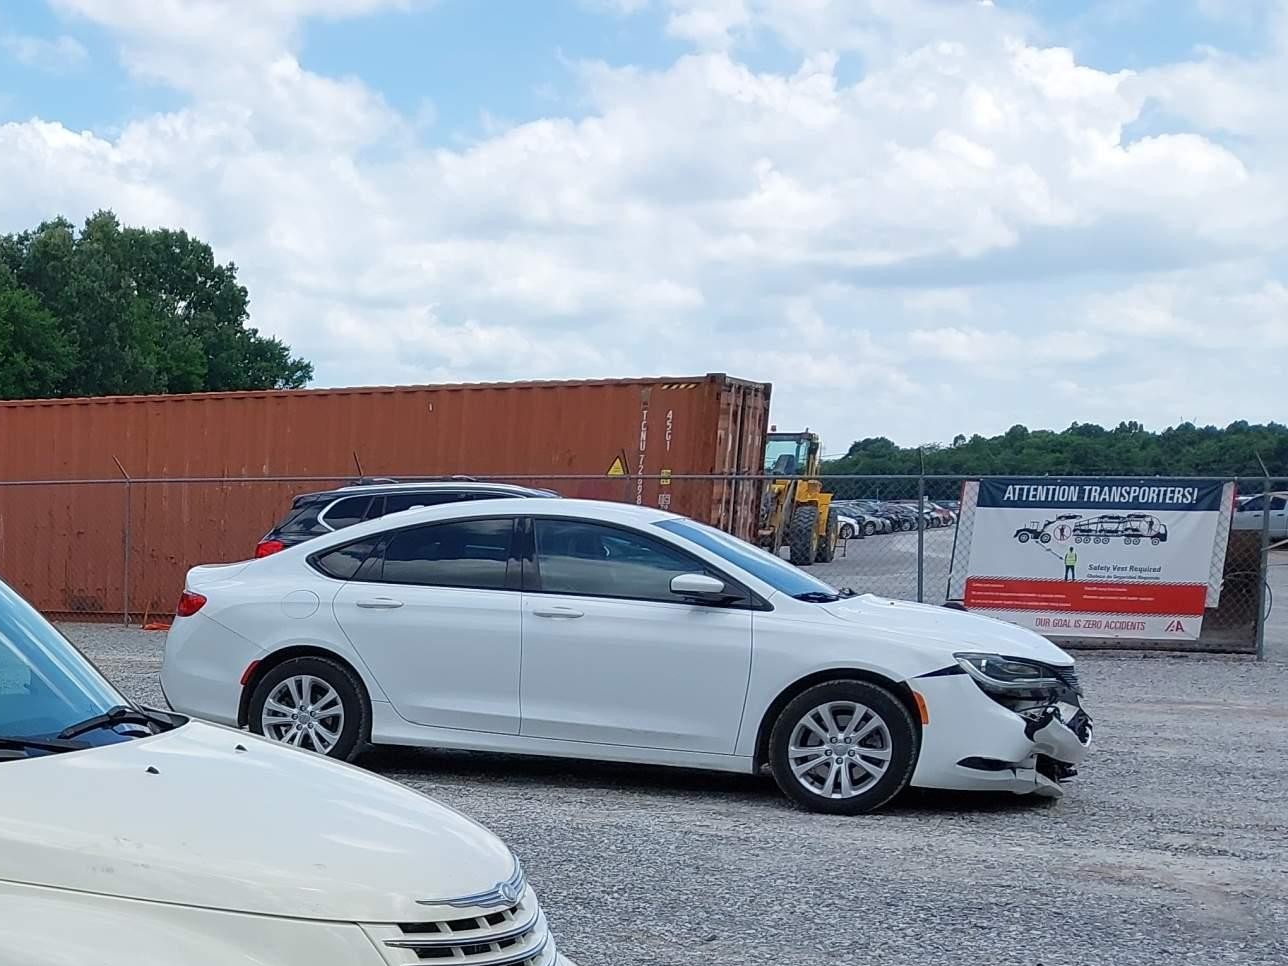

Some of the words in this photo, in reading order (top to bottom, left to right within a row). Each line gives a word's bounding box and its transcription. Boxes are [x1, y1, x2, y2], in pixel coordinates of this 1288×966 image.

[640, 411, 648, 451] TCNU
[1004, 485, 1079, 502] ATTENTION
[1083, 486, 1198, 504] TRANSPORTERS!
[1088, 564, 1111, 572] Safety
[1112, 564, 1128, 572] Vest
[1129, 565, 1162, 574] Required
[1035, 617, 1050, 627] OUR
[1052, 618, 1071, 628] GOAL
[1074, 619, 1081, 629] IS
[1083, 619, 1102, 630] ZERO
[1104, 620, 1146, 631] ACCIDENTS
